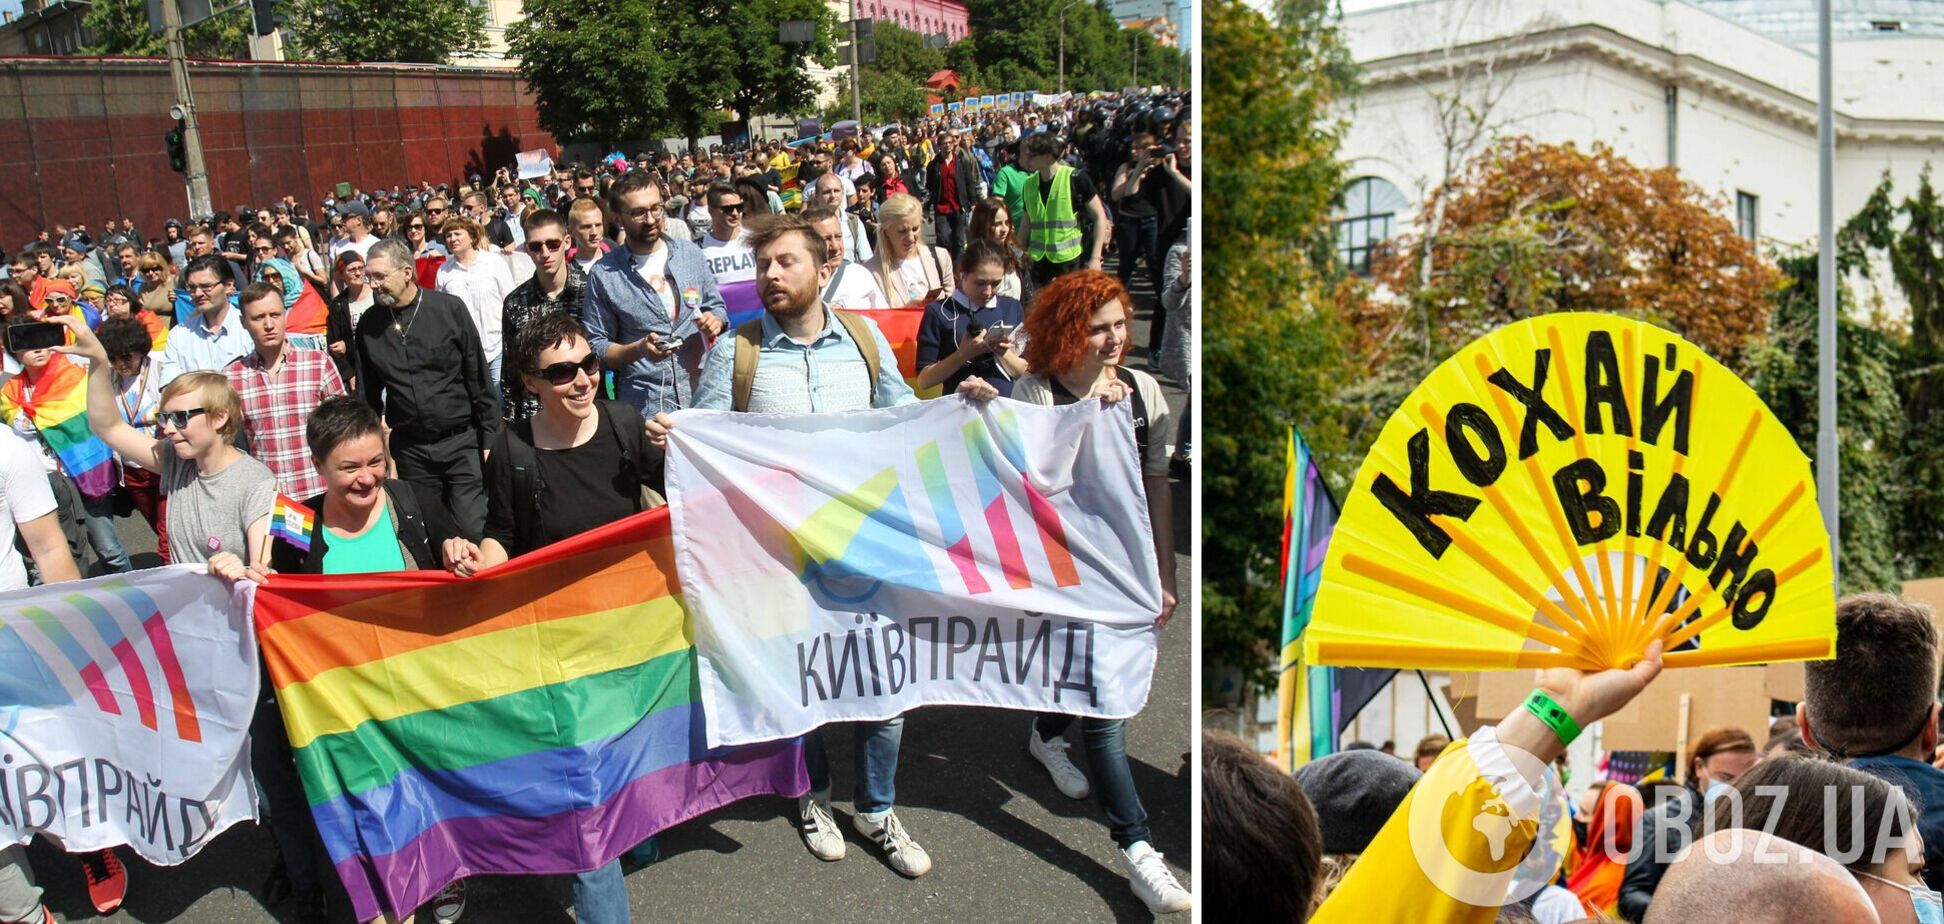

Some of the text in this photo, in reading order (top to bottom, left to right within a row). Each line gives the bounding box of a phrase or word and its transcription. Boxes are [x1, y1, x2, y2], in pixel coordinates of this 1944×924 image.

[1371, 330, 1694, 560] КОХАЙ
[797, 609, 1098, 708] КИЇВПРАЙД
[0, 752, 214, 858] ЇВПРАЙД
